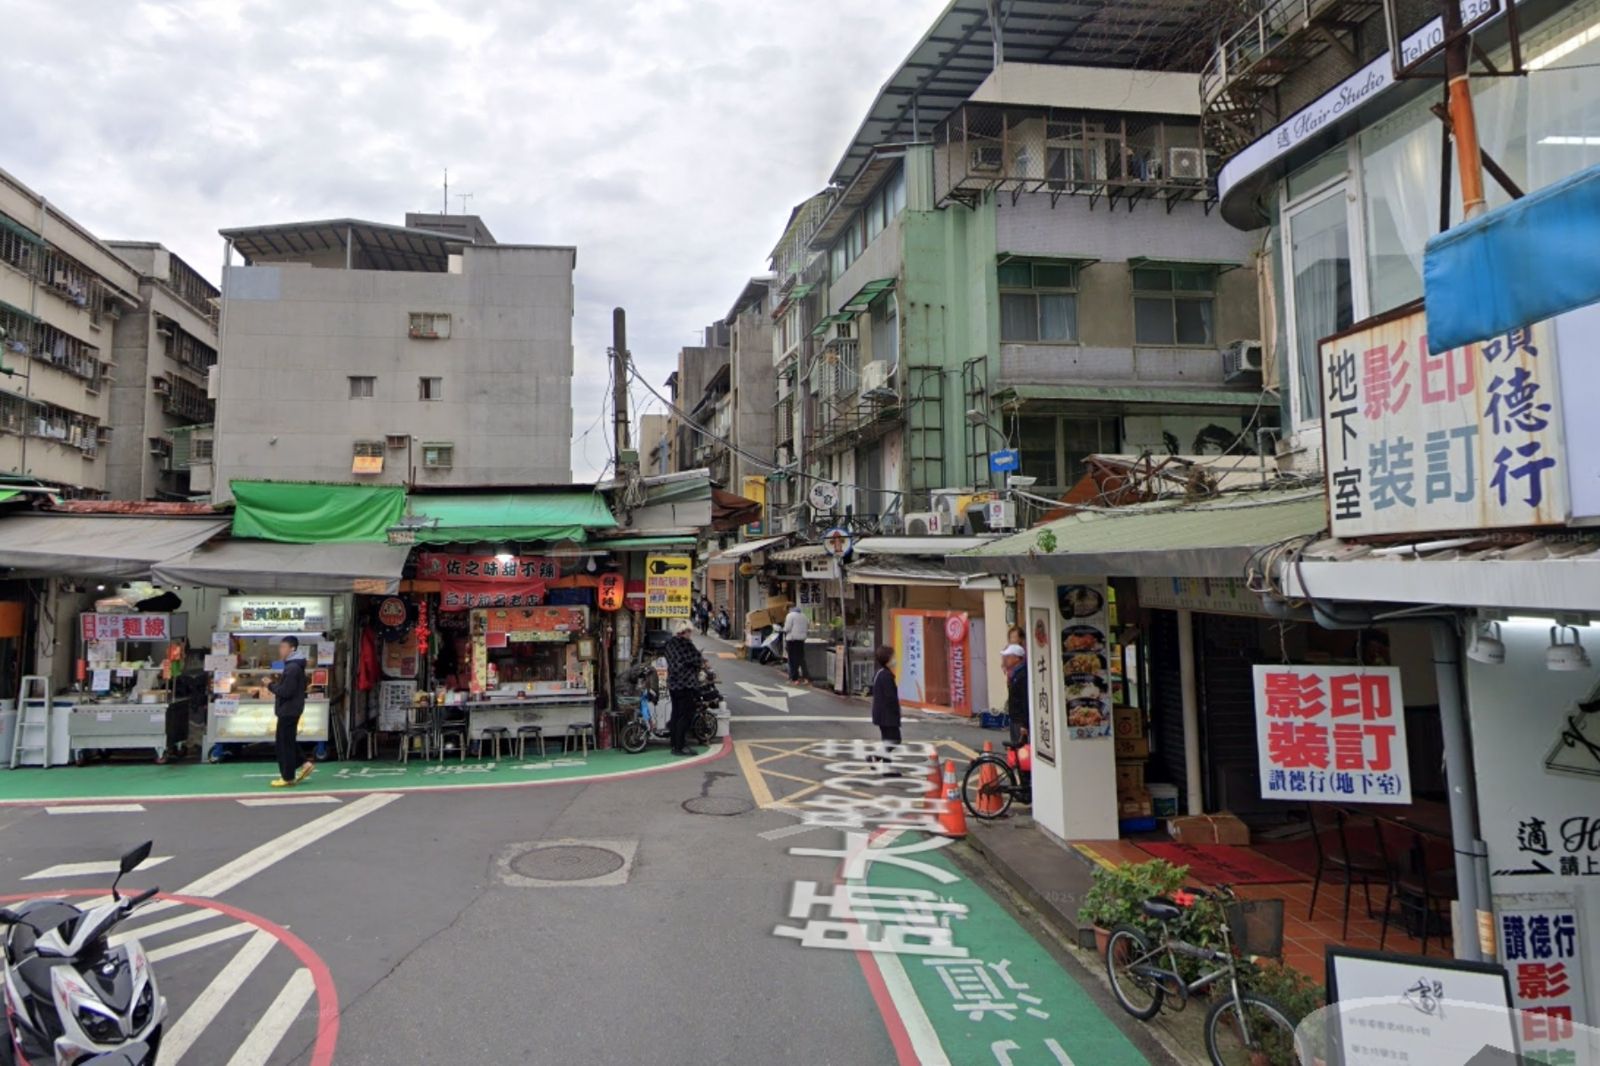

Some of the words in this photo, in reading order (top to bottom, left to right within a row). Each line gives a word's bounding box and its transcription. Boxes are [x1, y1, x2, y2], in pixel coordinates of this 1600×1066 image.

[1293, 109, 1331, 139] Hair
[1333, 71, 1385, 113] Studio
[1363, 336, 1476, 420] 影印
[1328, 349, 1361, 520] 地下室
[1368, 425, 1479, 510] 裝訂
[122, 616, 167, 639] 麵線
[1265, 673, 1393, 720] 影印
[1268, 721, 1396, 770] 裝訂
[1519, 817, 1552, 856] 適
[1559, 855, 1600, 876] 請上
[1503, 914, 1576, 960] 讚德行
